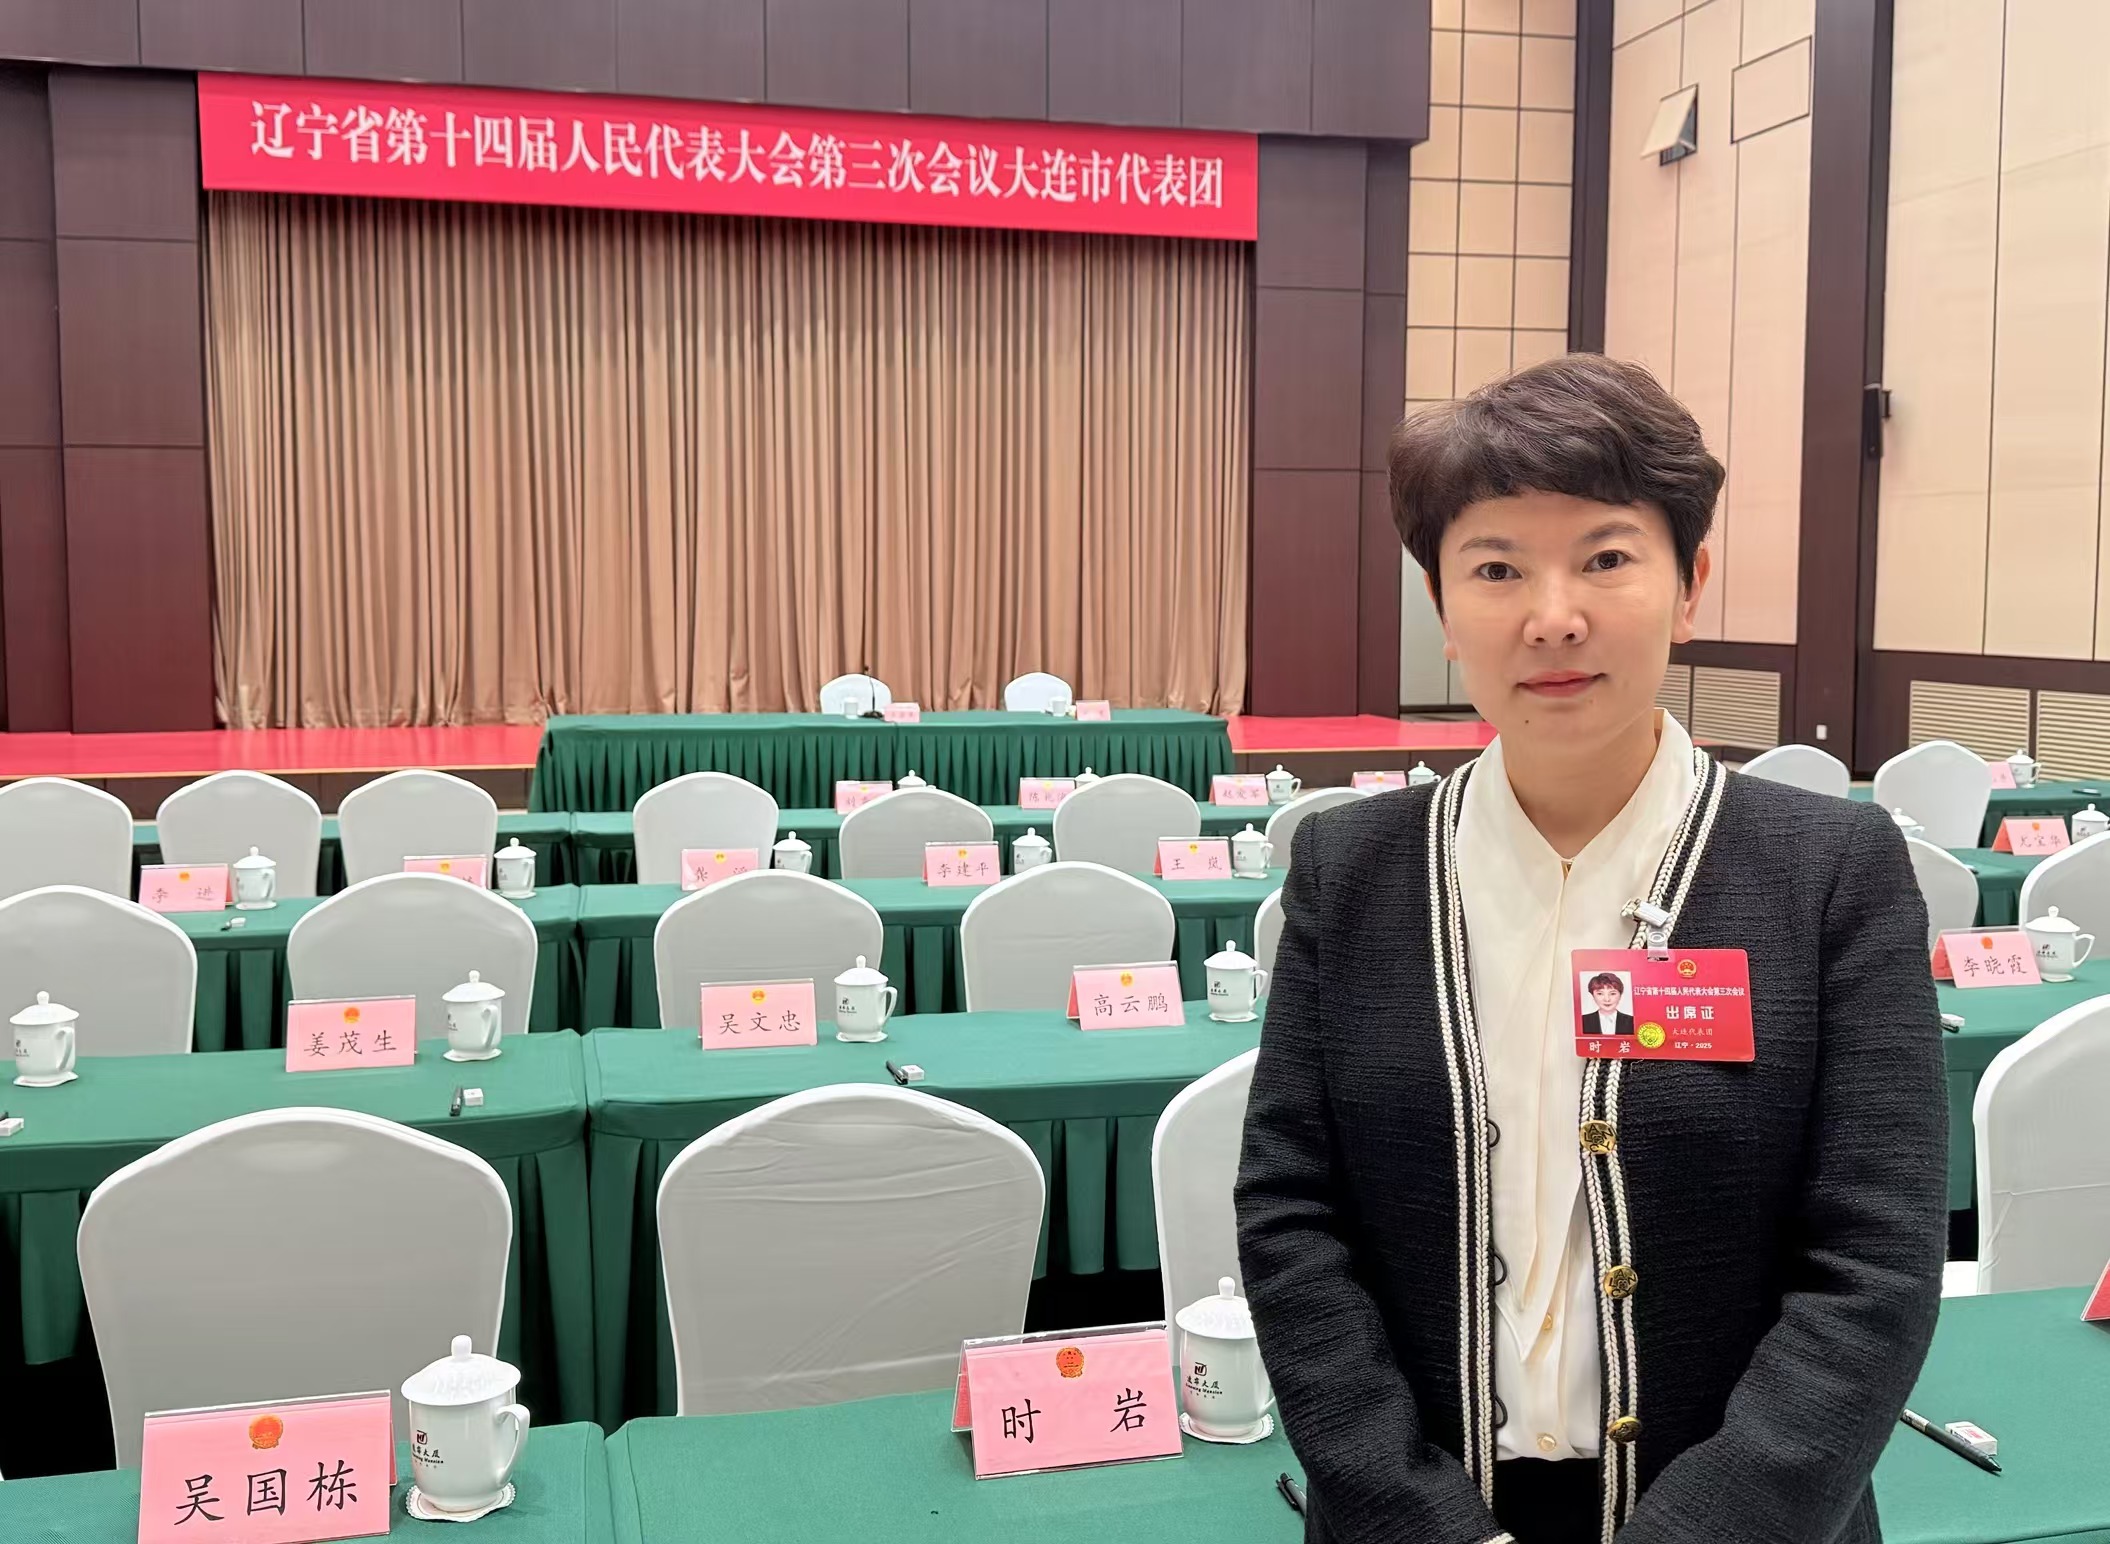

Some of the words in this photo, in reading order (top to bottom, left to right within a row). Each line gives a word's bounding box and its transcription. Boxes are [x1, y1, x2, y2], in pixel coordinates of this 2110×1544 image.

[250, 100, 1223, 208] 辽宁省第十四届人民代表大会第三次会议大连市代表团
[937, 861, 989, 878] 李建平
[1171, 856, 1223, 872] 王岚
[1963, 954, 2028, 977] 李晓霞
[1634, 986, 1745, 996] 辽宁省第十四届人民代表大会第三次会议
[1094, 991, 1169, 1016] 高云鹏
[1666, 1005, 1714, 1020] 出席证
[718, 1010, 802, 1034] 吴文忠
[303, 1030, 398, 1057] 姜茂生
[1589, 1040, 1632, 1053] 时岩
[1001, 1388, 1148, 1443] 时岩
[173, 1459, 359, 1526] 吴国栋
